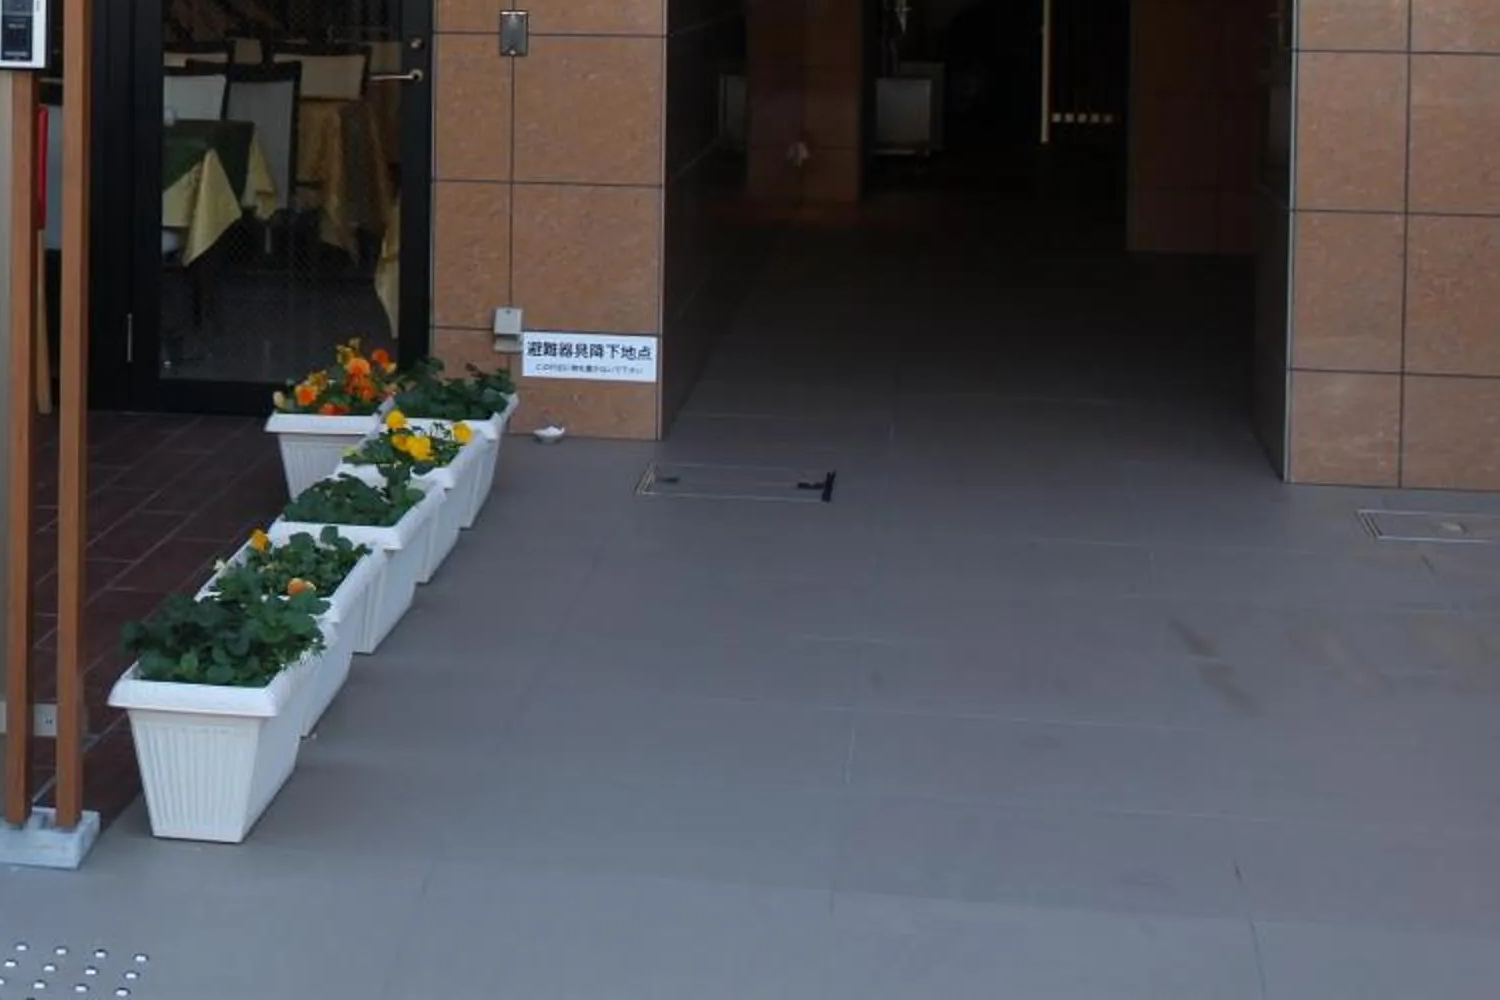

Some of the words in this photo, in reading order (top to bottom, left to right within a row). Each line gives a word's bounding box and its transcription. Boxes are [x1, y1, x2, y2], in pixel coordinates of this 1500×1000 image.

[526, 340, 653, 361] 避難器具降下地点
